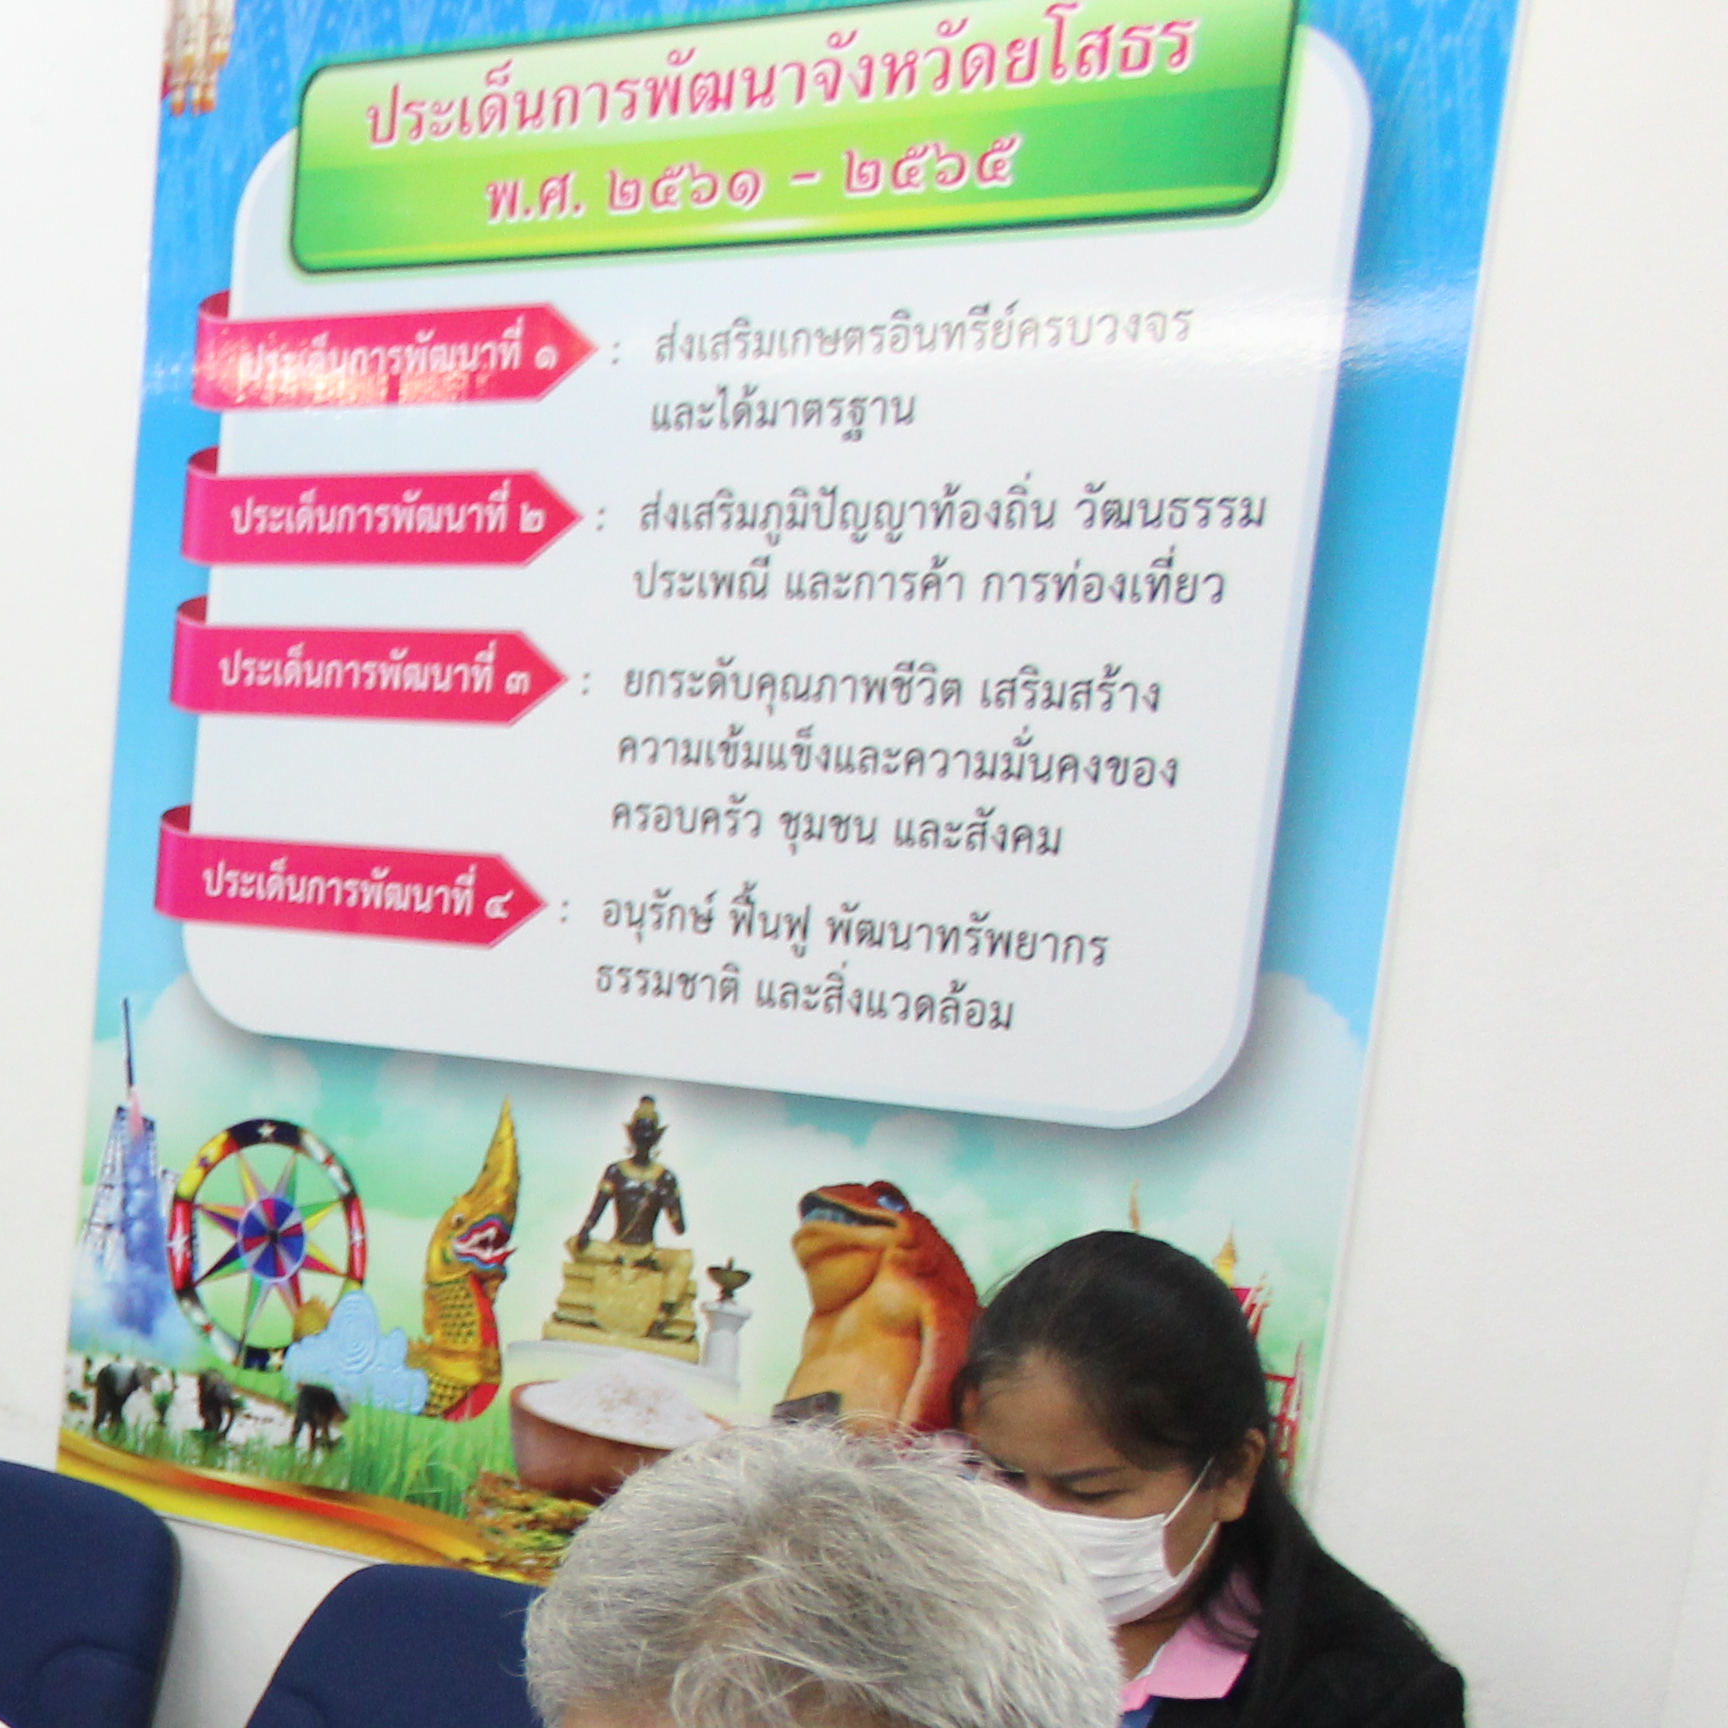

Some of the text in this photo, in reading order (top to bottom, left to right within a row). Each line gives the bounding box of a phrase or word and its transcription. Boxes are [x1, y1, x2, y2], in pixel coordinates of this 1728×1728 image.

[366, 2, 1197, 146] ประเด็นการพัฒนาจังหวัดยโสธร
[486, 170, 585, 222] พ.ศ.
[606, 161, 762, 212] ๒๕๖๑
[844, 133, 1022, 198] ๒๕๖๕
[242, 314, 524, 381] ประเด็นการพัฒนาที่
[533, 345, 560, 371] ๑
[655, 300, 1193, 364] ส่งเสริมเกษตรอินทรีย์ครบวงจร
[650, 382, 917, 443] และได้มาตรฐาน
[230, 478, 510, 535] ประเด็นการพัฒนาที่
[518, 501, 545, 534] ๒
[639, 471, 1057, 547] ส่งเสริมภูมิปัญญาท้องถิ่น
[1075, 481, 1267, 529] วัฒนธรรม
[632, 545, 1226, 604] ประเพณี และการค้า การท่องเที่ยว
[218, 640, 497, 694] ประเด็นการพัฒนาที่
[504, 671, 532, 695] ๓
[623, 655, 962, 717] ยกระดับคุณภาพชีวิต
[981, 662, 1161, 712] เสริมสร้าง
[617, 723, 1179, 788] ความเข้มแข็งและความมั่นคงของ
[612, 792, 1063, 856] ครอบครัว ชุมชน และสังคม
[202, 857, 476, 917] ประเด็นการพัฒนาที่
[483, 889, 514, 919] ๔
[602, 882, 717, 944] อนุรักษ์
[729, 880, 811, 958] ฟื้นฟู
[826, 899, 1109, 968] พัฒนาทรัพยากร
[595, 960, 1014, 1031] ธรรมชาติ และสิ่งแวดล้อม
